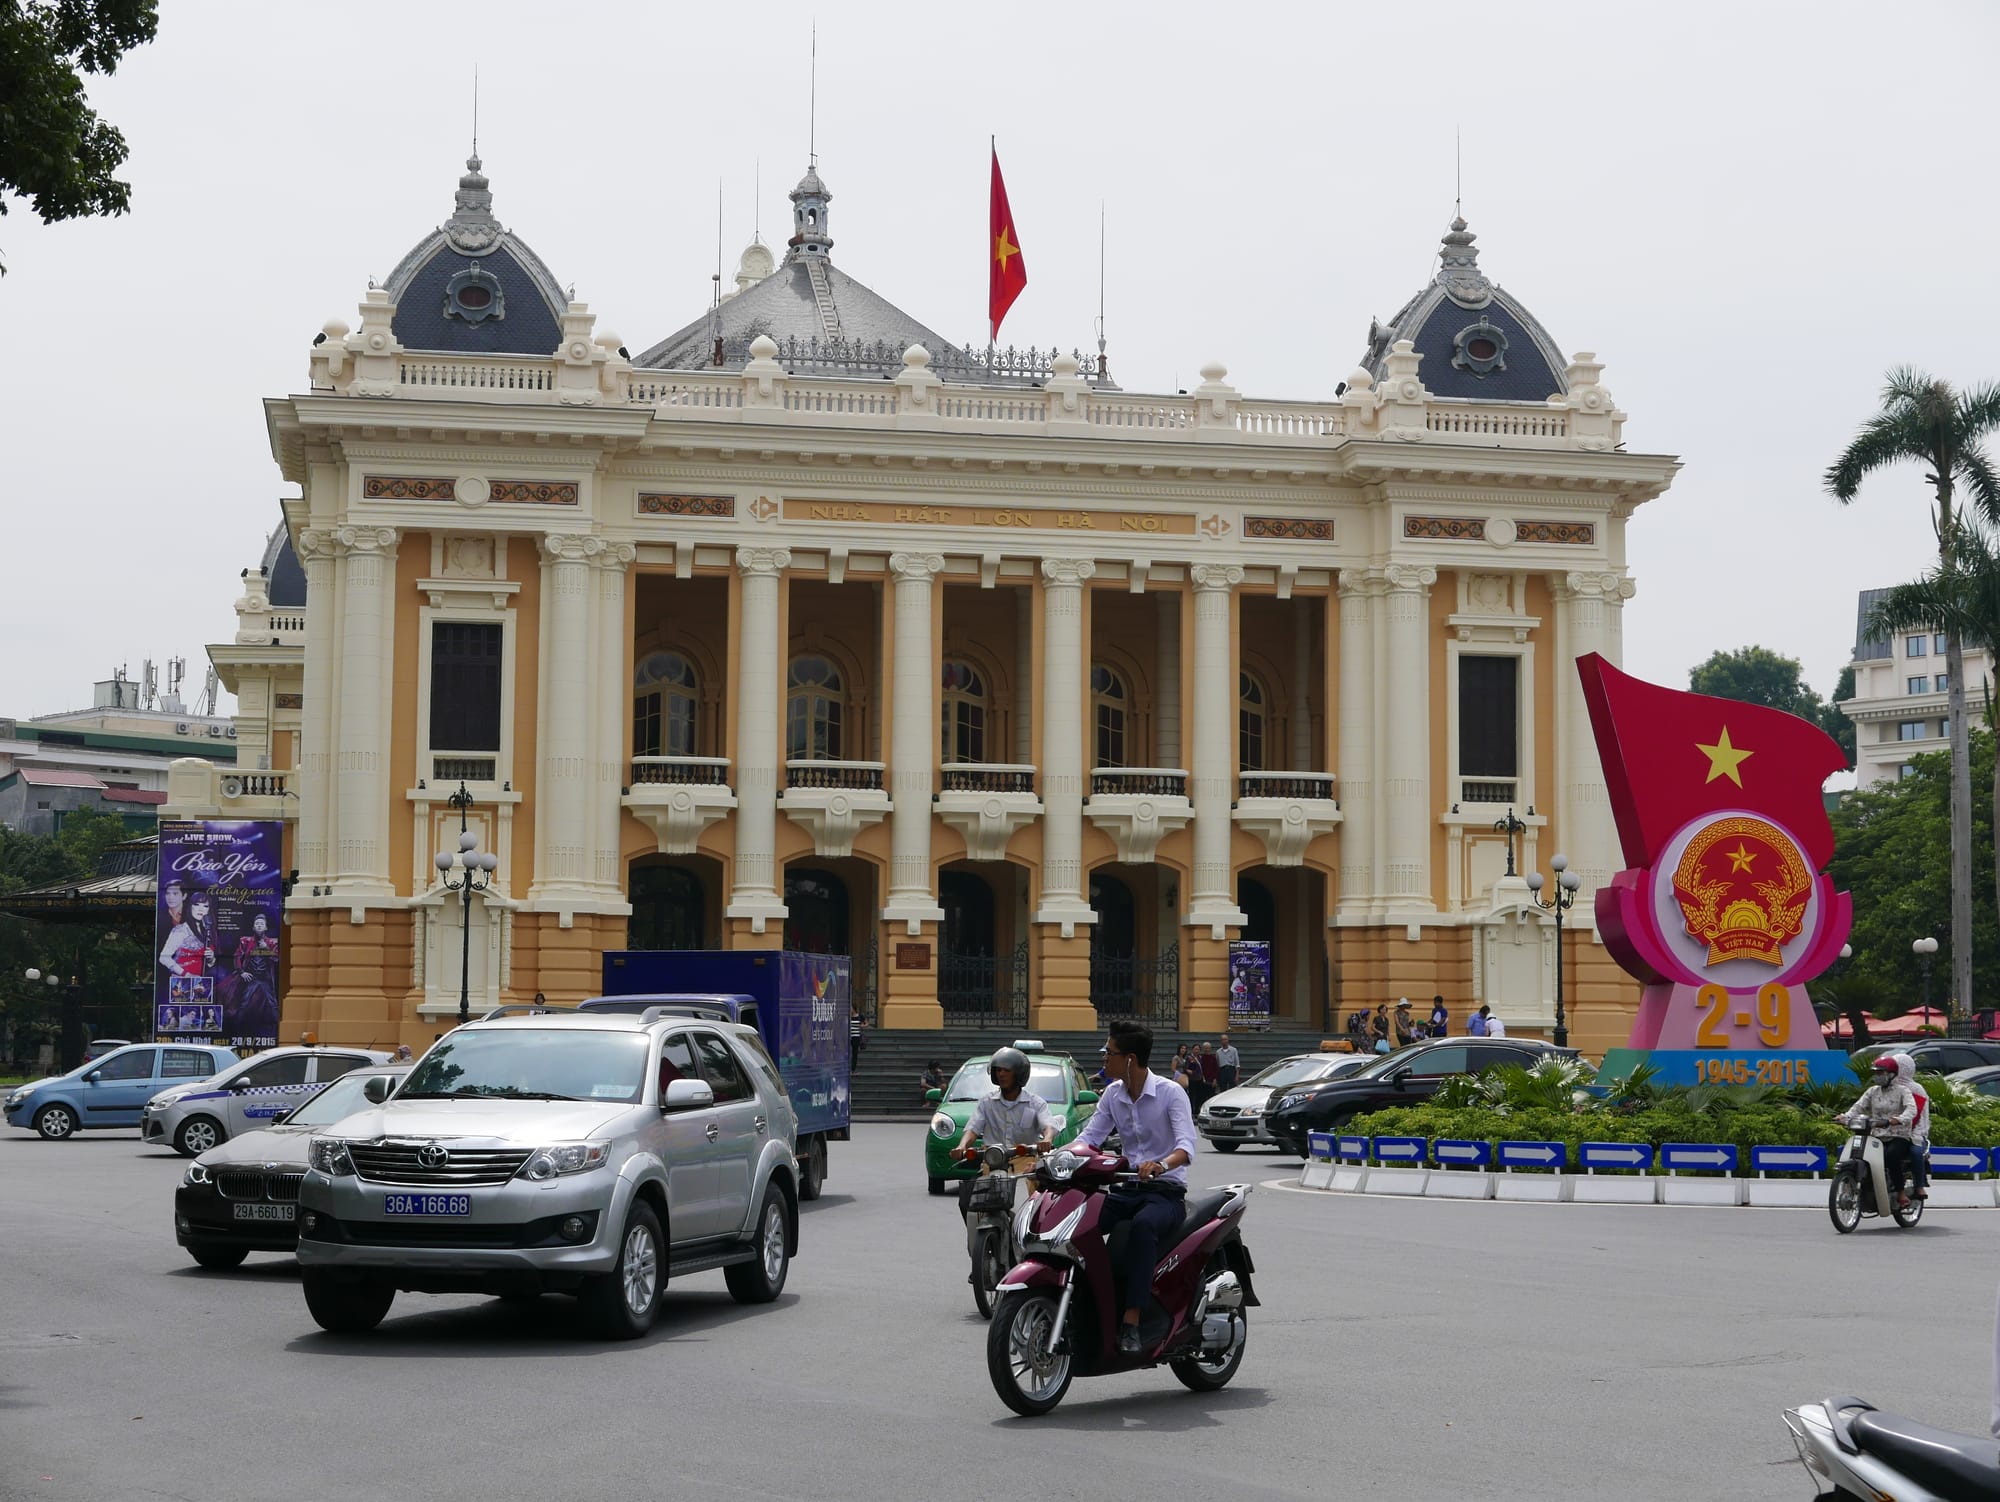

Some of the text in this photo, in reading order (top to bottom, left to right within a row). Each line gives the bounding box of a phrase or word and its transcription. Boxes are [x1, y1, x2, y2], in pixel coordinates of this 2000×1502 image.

[809, 503, 1169, 533] NHÀ HÁT LỚN HÀ NỘI
[184, 833, 233, 842] LIVE SHOW
[171, 848, 269, 884] Bảo Yến
[1723, 938, 1765, 950] VIỆT NAM
[812, 995, 834, 1022] Dulux
[1695, 982, 1791, 1048] 2-9
[1695, 1059, 1809, 1084] 1945-2015
[235, 1204, 293, 1220] 29A-660.19
[386, 1195, 468, 1214] 36A-166.68
